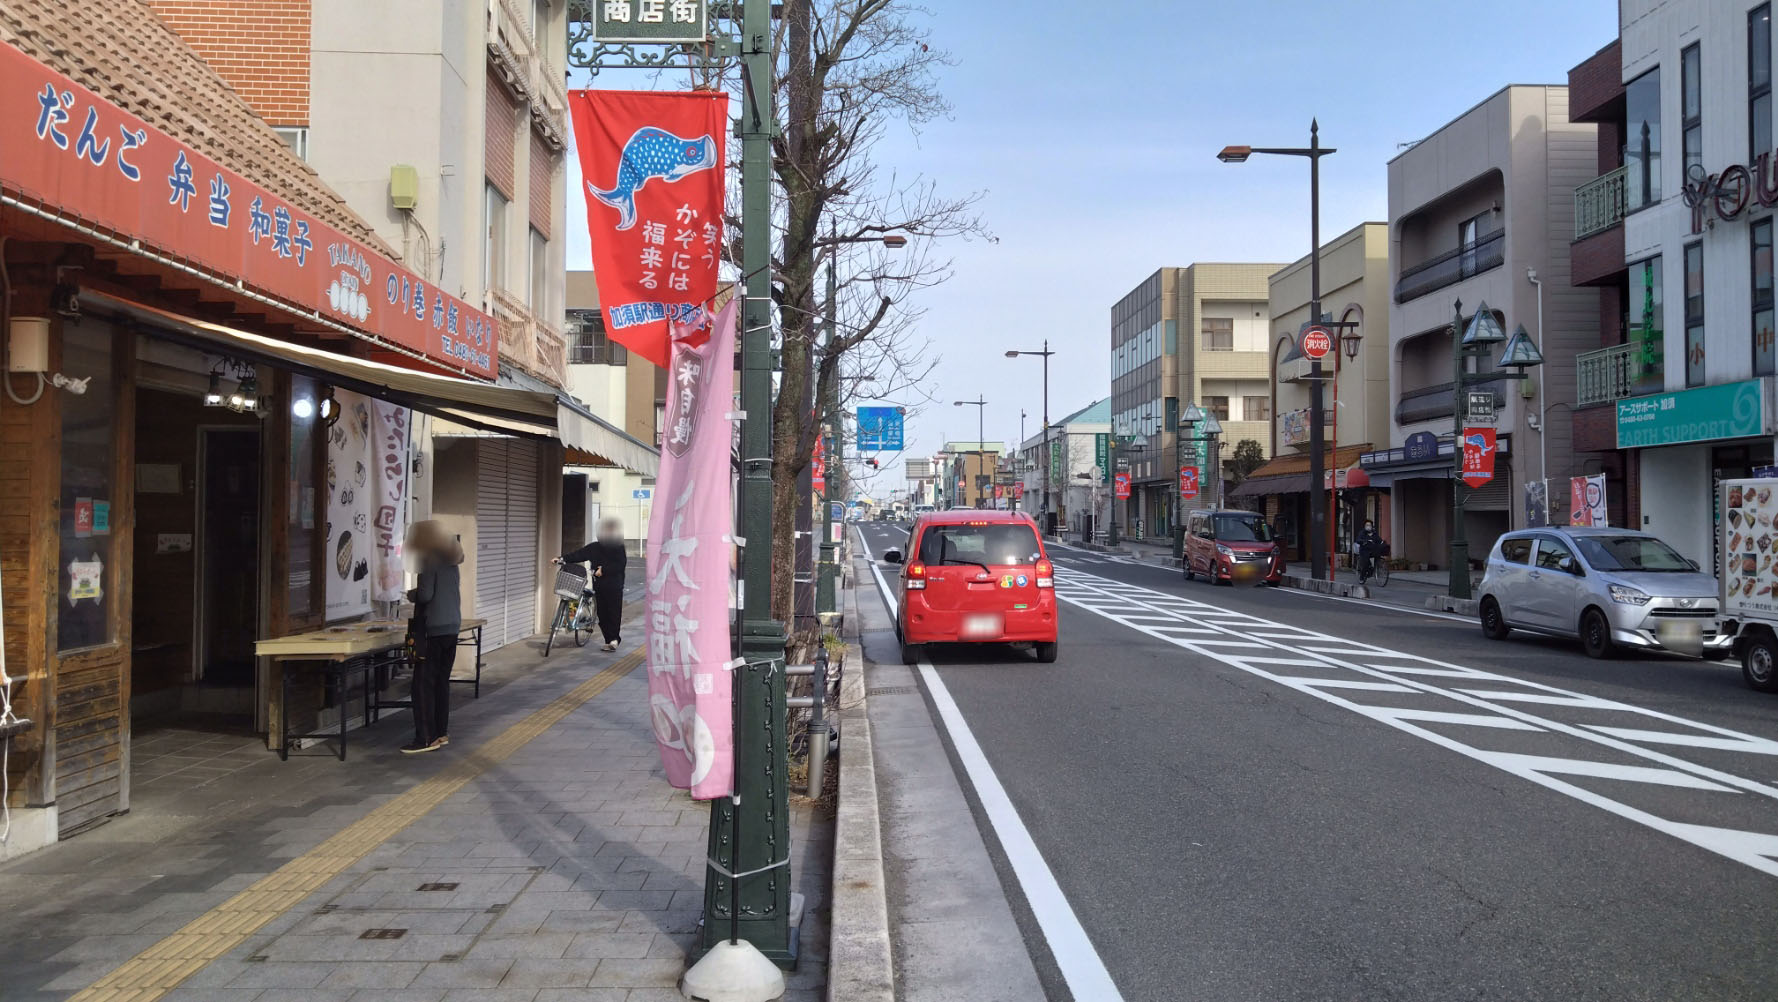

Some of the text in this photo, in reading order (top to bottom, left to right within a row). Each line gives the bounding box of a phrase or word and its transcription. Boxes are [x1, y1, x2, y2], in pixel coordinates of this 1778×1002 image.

[604, 0, 698, 23] 商店街
[36, 82, 313, 267] だんご 弁当 和菓子
[328, 242, 372, 285] TAKANO
[639, 220, 667, 289] 福来る
[668, 203, 698, 291] かぞには
[702, 221, 718, 270] 笑う
[387, 272, 426, 320] のり巻
[432, 291, 459, 335] 赤飯
[441, 334, 453, 357] TEL
[1306, 338, 1329, 350] 消火栓
[1619, 400, 1660, 416] アースサポート
[1617, 420, 1729, 447] EARTH SUPPORT
